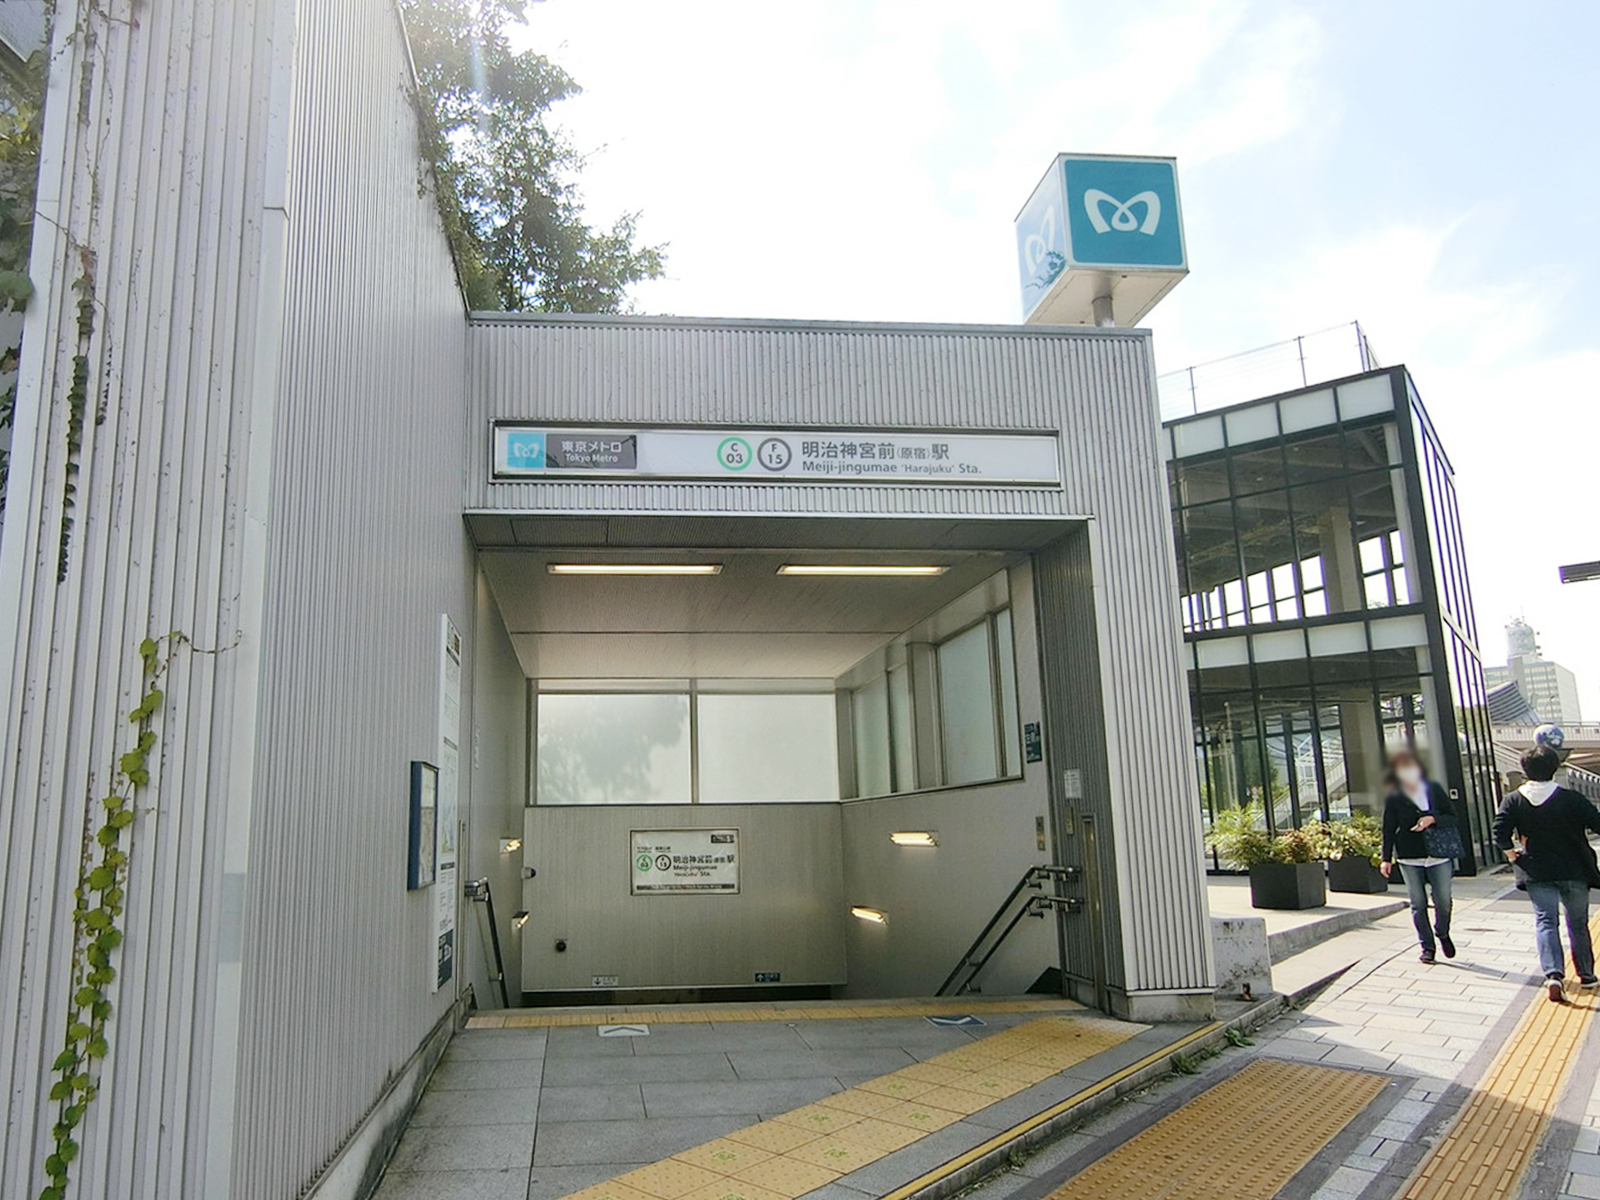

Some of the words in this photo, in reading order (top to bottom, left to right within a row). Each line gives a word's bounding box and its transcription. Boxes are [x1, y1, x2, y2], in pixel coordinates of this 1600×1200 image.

[561, 441, 622, 453] 東京メトロ
[730, 442, 739, 452] C
[771, 443, 777, 452] F
[565, 453, 591, 463] Tokyo
[592, 454, 619, 463] Metro
[726, 453, 743, 464] 03
[768, 454, 783, 465] 15
[802, 461, 898, 475] Meiji-jingumae
[958, 463, 983, 474] Sta.
